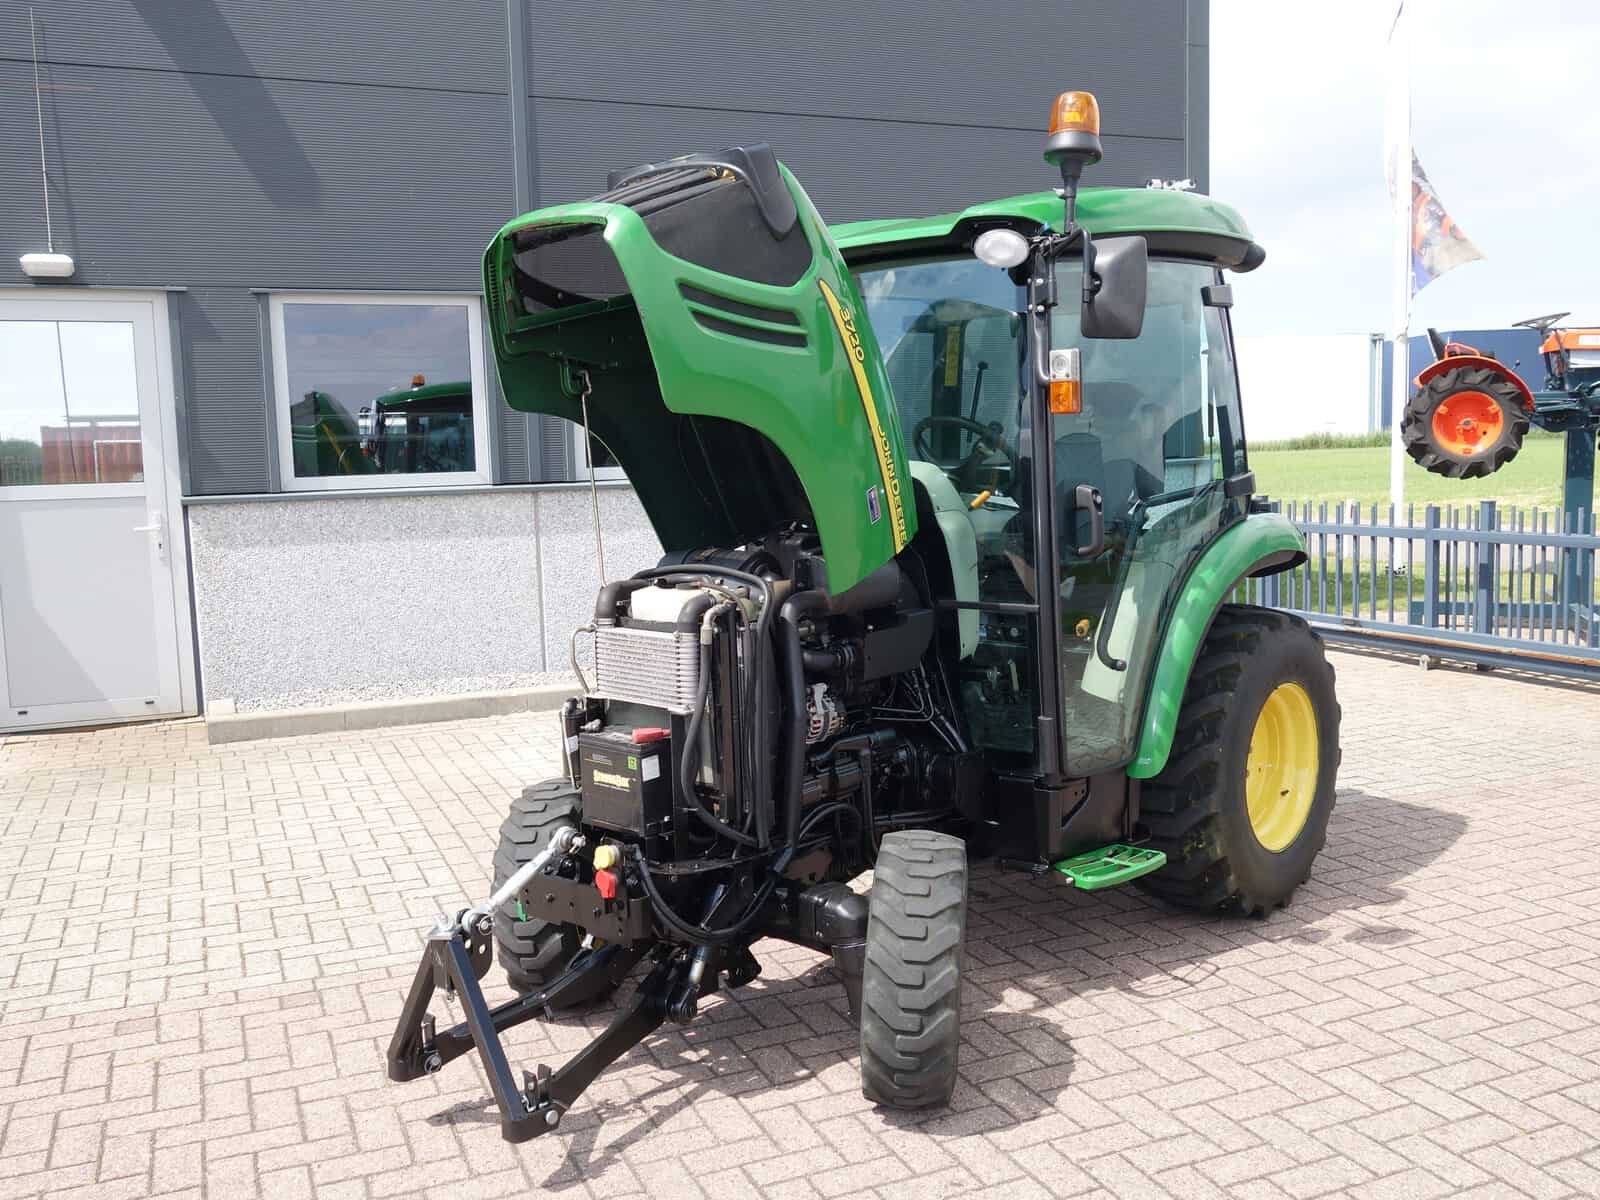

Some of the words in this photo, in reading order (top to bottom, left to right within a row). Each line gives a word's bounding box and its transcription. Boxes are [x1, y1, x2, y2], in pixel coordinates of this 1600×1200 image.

[840, 304, 866, 362] 3720
[877, 427, 896, 481] JOHN
[890, 478, 907, 544] DEERE
